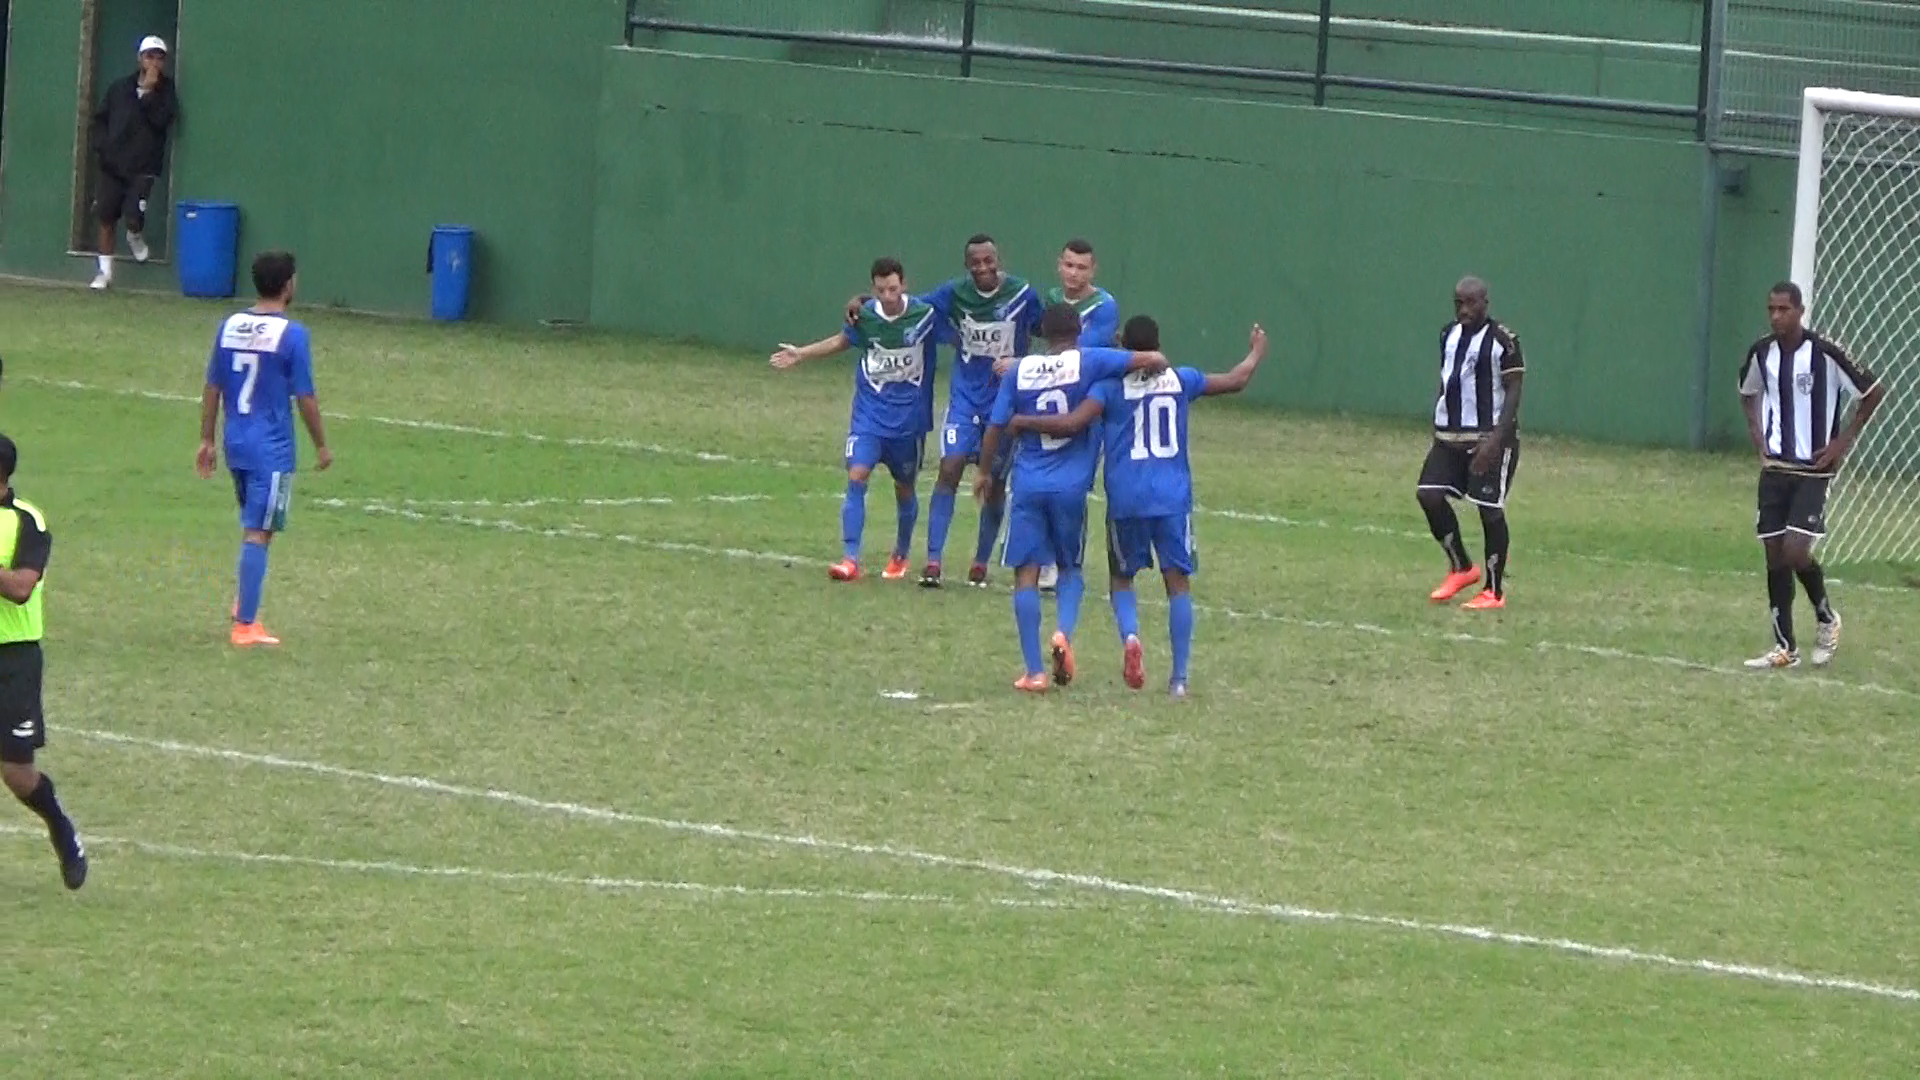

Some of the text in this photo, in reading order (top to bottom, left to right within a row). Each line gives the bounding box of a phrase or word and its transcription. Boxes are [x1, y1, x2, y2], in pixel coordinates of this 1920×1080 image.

[231, 352, 259, 414] 7
[947, 429, 957, 444] 8
[1130, 395, 1180, 460] 10
